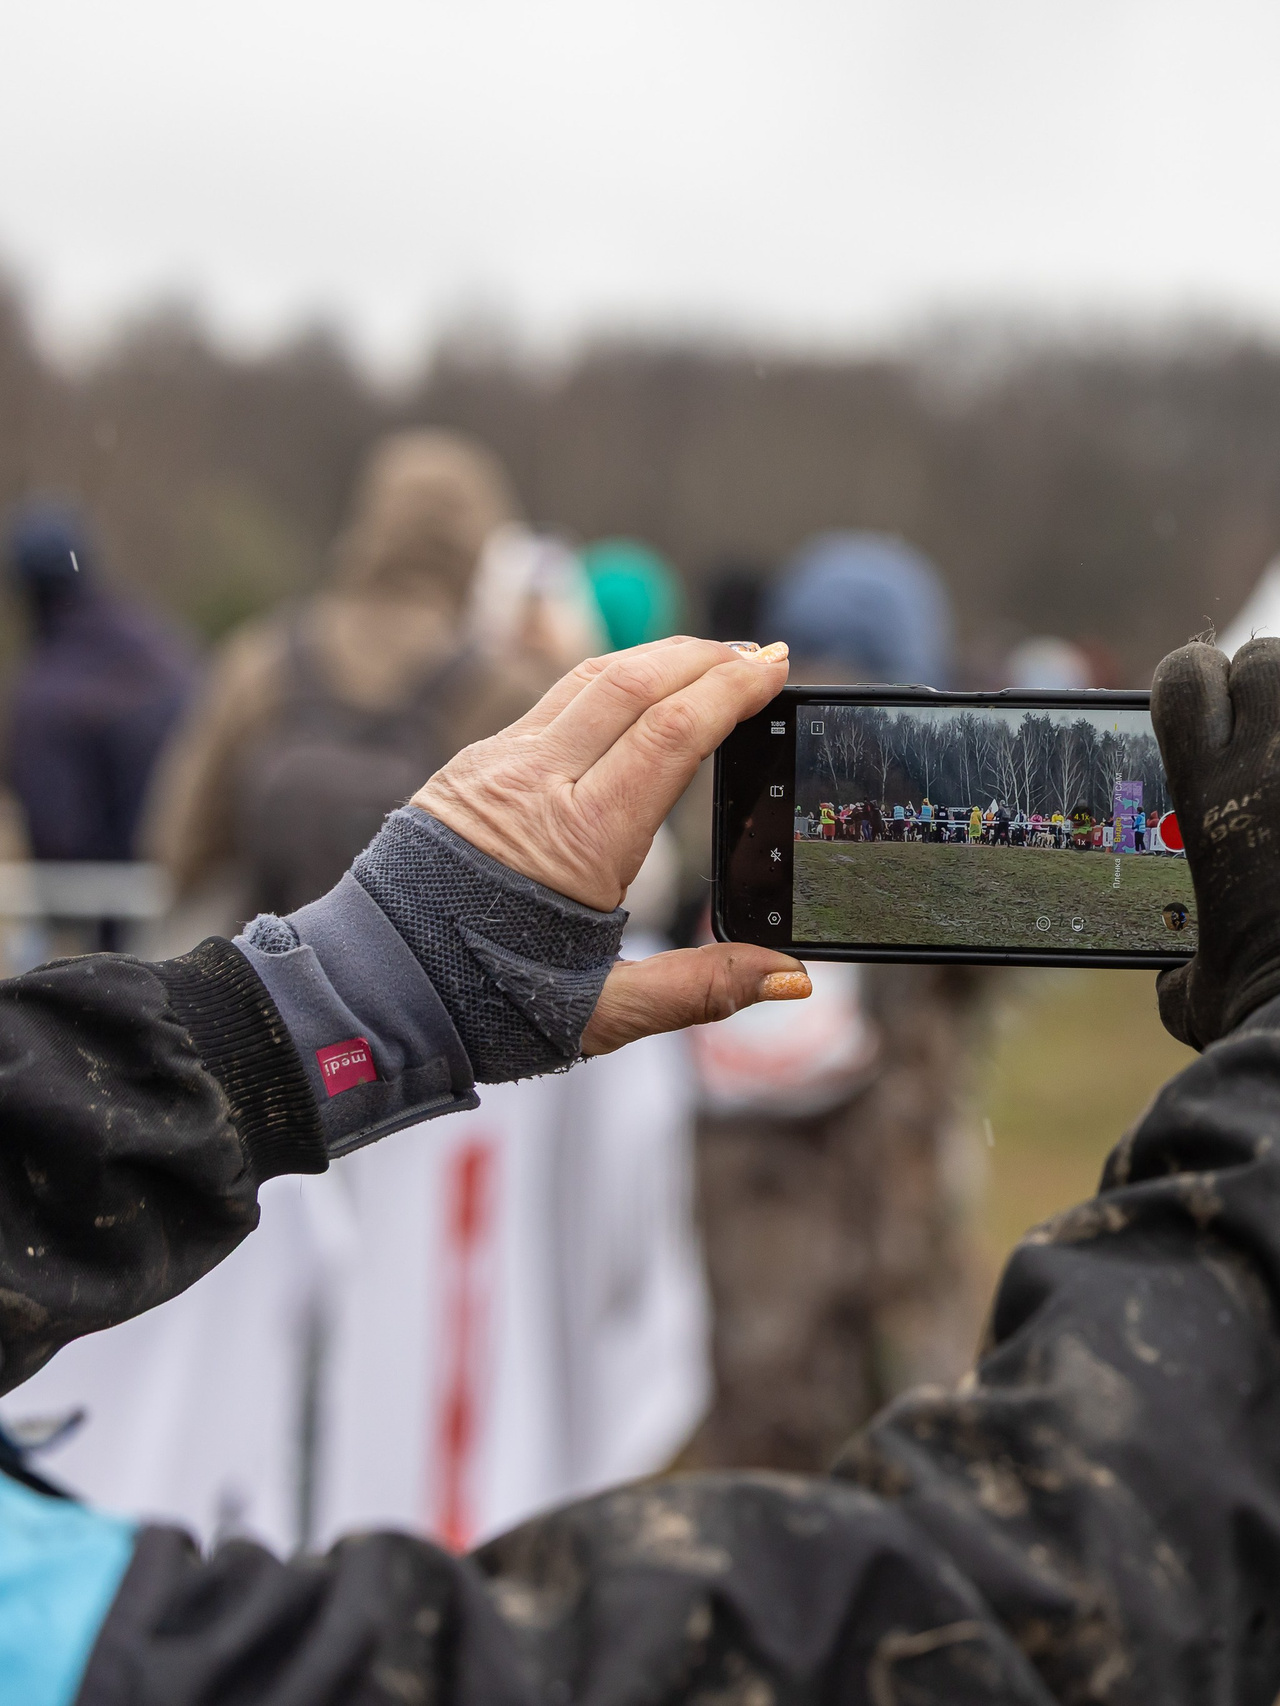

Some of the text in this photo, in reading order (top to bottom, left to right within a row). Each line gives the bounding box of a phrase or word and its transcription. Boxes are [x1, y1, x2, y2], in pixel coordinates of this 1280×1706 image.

[1115, 772, 1123, 802] AI CAM
[1073, 812, 1090, 821] 4.1x
[1077, 838, 1086, 846] 1x
[1114, 816, 1122, 843] Видео
[1113, 858, 1121, 889] Пленка
[324, 1053, 366, 1076] medi
